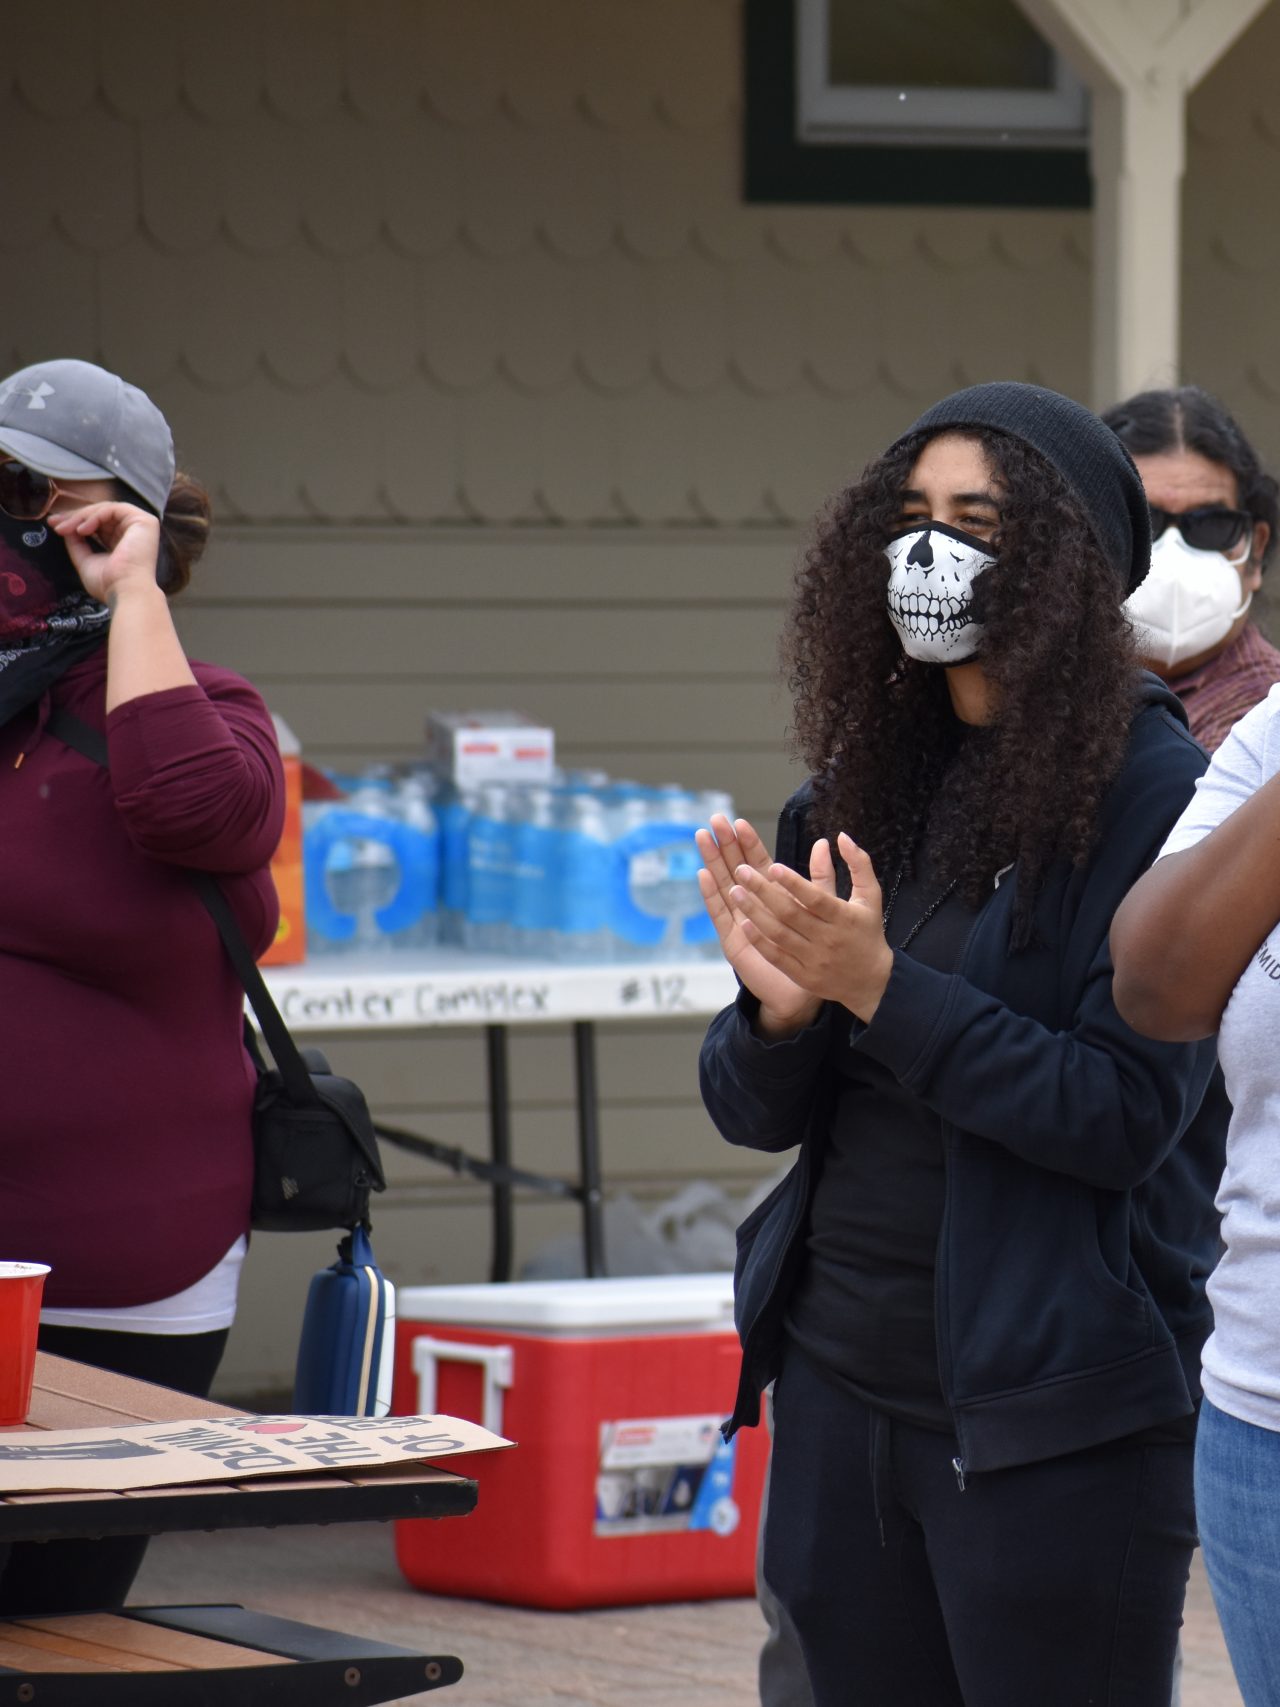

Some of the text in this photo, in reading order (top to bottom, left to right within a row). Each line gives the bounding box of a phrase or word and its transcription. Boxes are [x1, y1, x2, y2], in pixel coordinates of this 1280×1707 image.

[282, 986, 403, 1019] Center
[414, 980, 549, 1018] Complex
[144, 1427, 297, 1470] DENIAL
[274, 1432, 382, 1466] THE
[379, 1433, 466, 1453] OF
